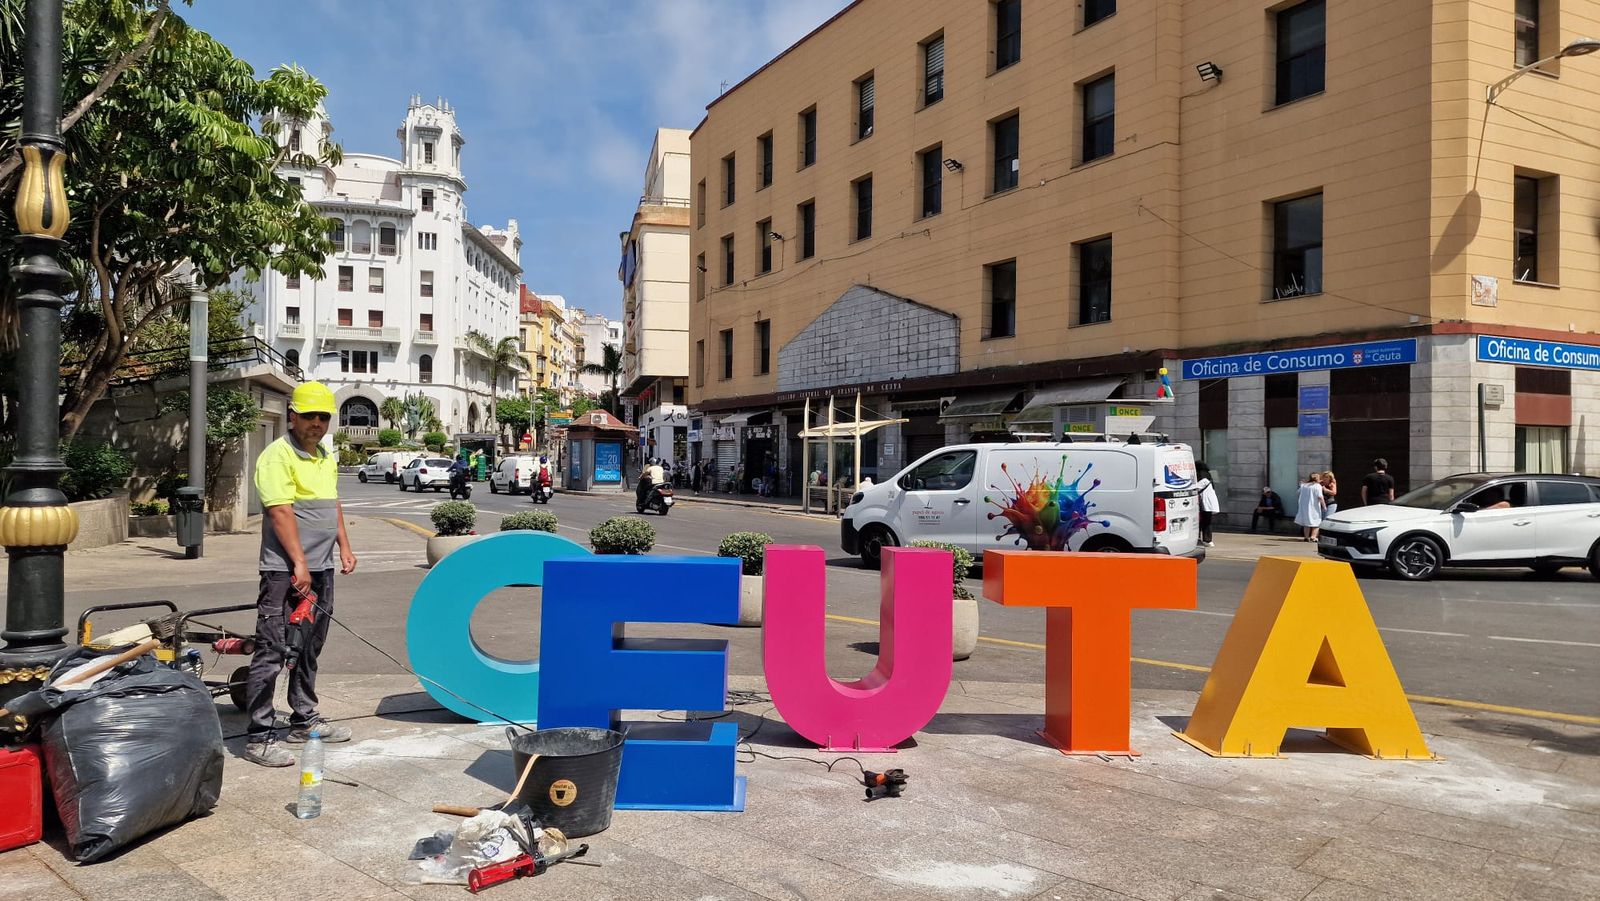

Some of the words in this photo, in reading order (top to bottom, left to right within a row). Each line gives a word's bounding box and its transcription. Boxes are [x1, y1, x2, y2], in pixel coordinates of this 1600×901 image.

[1372, 351, 1402, 362] Ceuta
[1487, 339, 1531, 360] Oficina
[1534, 343, 1549, 362] de
[1553, 346, 1600, 367] Consum
[1191, 360, 1239, 376] Oficina
[1243, 356, 1262, 372] de
[1267, 353, 1345, 370] Consumo
[1119, 408, 1139, 416] ONCE
[1072, 424, 1091, 432] ONCE
[607, 454, 618, 464] 20
[407, 529, 1436, 812] CEUTA
